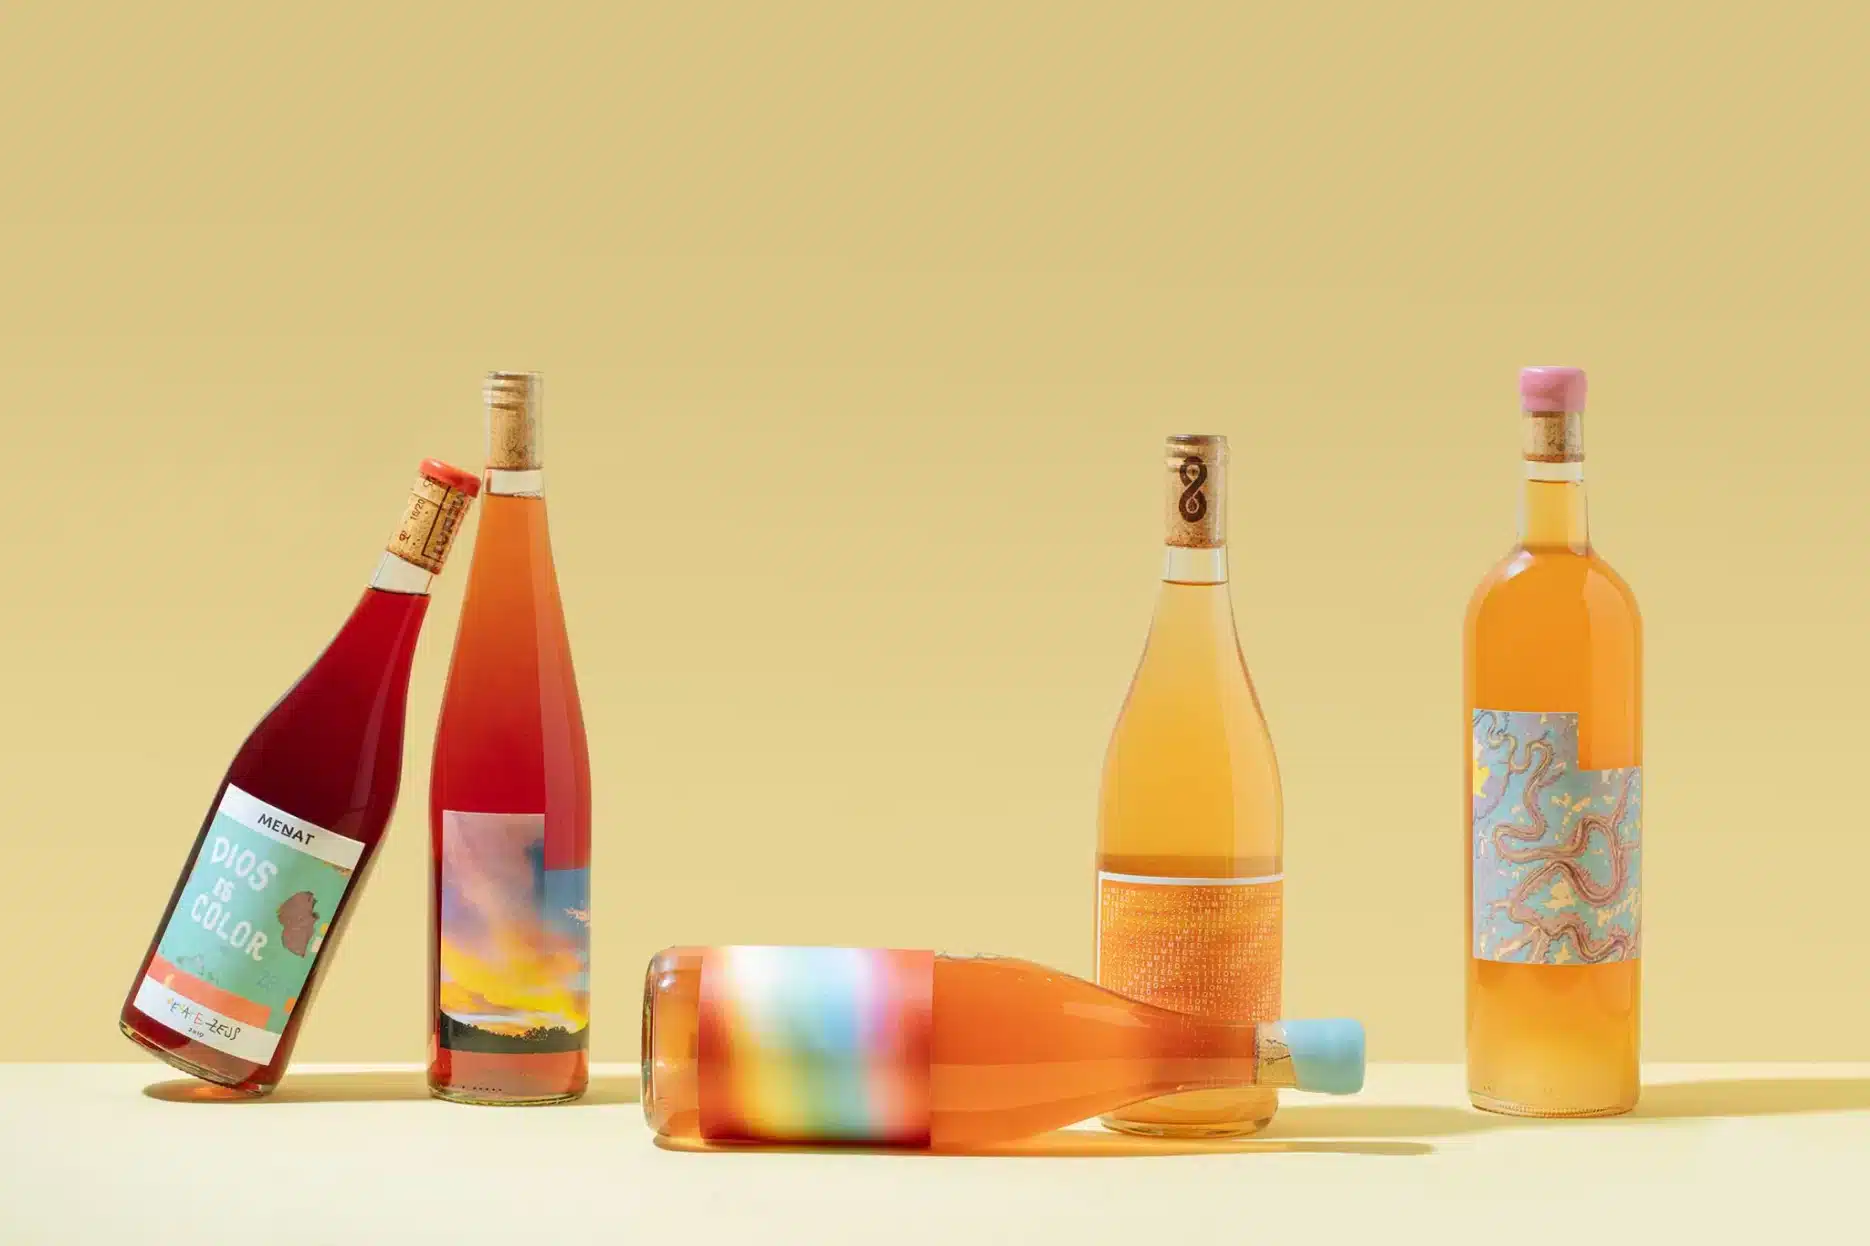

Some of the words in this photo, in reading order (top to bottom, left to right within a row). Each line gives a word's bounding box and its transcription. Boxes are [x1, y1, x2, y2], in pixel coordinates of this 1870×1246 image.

[257, 812, 315, 846] MENAT
[210, 837, 278, 892] DIOS
[190, 892, 268, 961] COLOR
